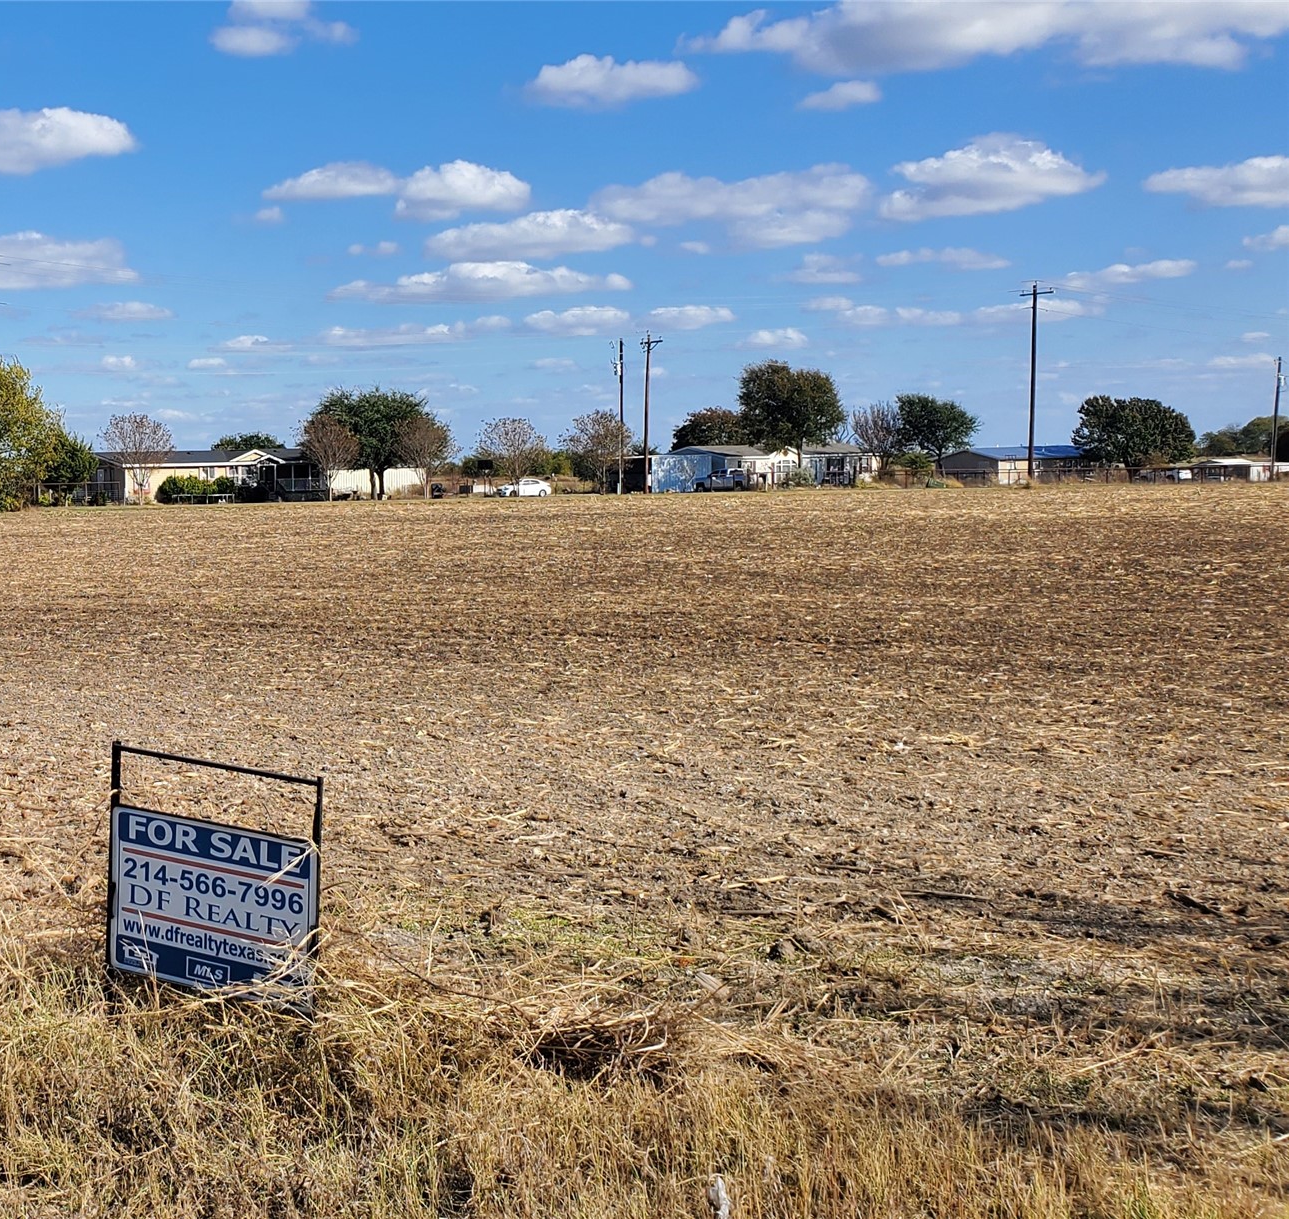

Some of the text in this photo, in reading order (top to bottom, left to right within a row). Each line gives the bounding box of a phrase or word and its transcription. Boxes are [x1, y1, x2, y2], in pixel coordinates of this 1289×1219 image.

[128, 815, 301, 873] FOR SALE
[123, 858, 304, 914] 214-566-7996
[128, 883, 171, 911] DF
[123, 918, 296, 967] www.dfrealtytexas.co
[193, 964, 224, 981] MLS
